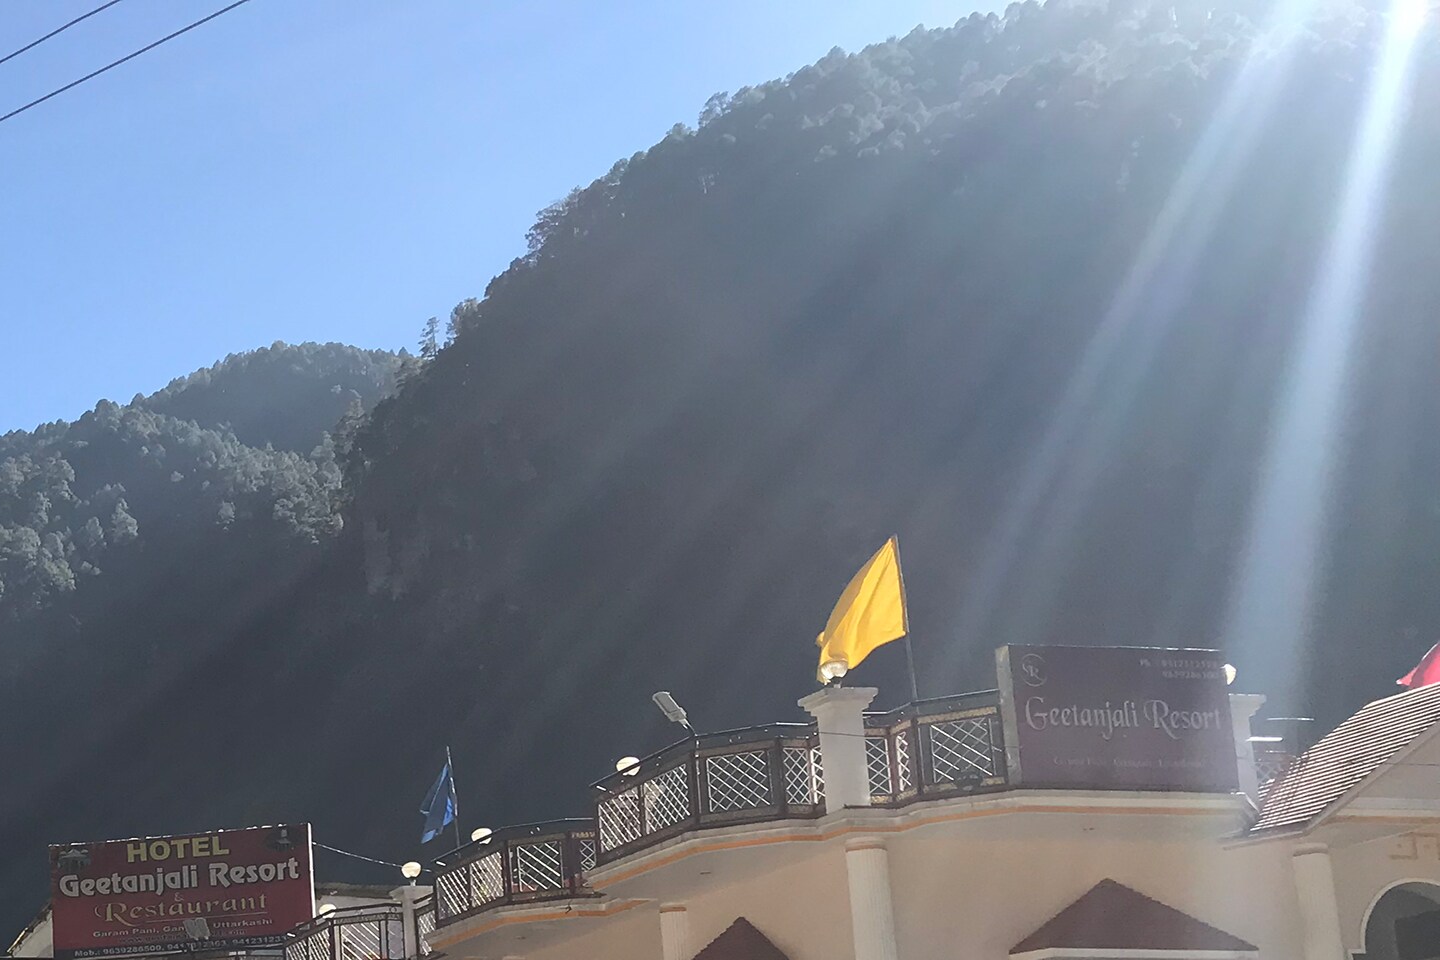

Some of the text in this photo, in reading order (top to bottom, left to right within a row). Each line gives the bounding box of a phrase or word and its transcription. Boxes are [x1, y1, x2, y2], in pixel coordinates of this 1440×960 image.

[1025, 696, 1222, 741] Geetanjali Resort
[126, 836, 230, 863] HOTEL
[59, 857, 301, 897] Geetanjali Resort
[94, 893, 267, 927] Restaurant
[92, 930, 129, 938] Garam
[212, 918, 273, 928] Uttarkashi
